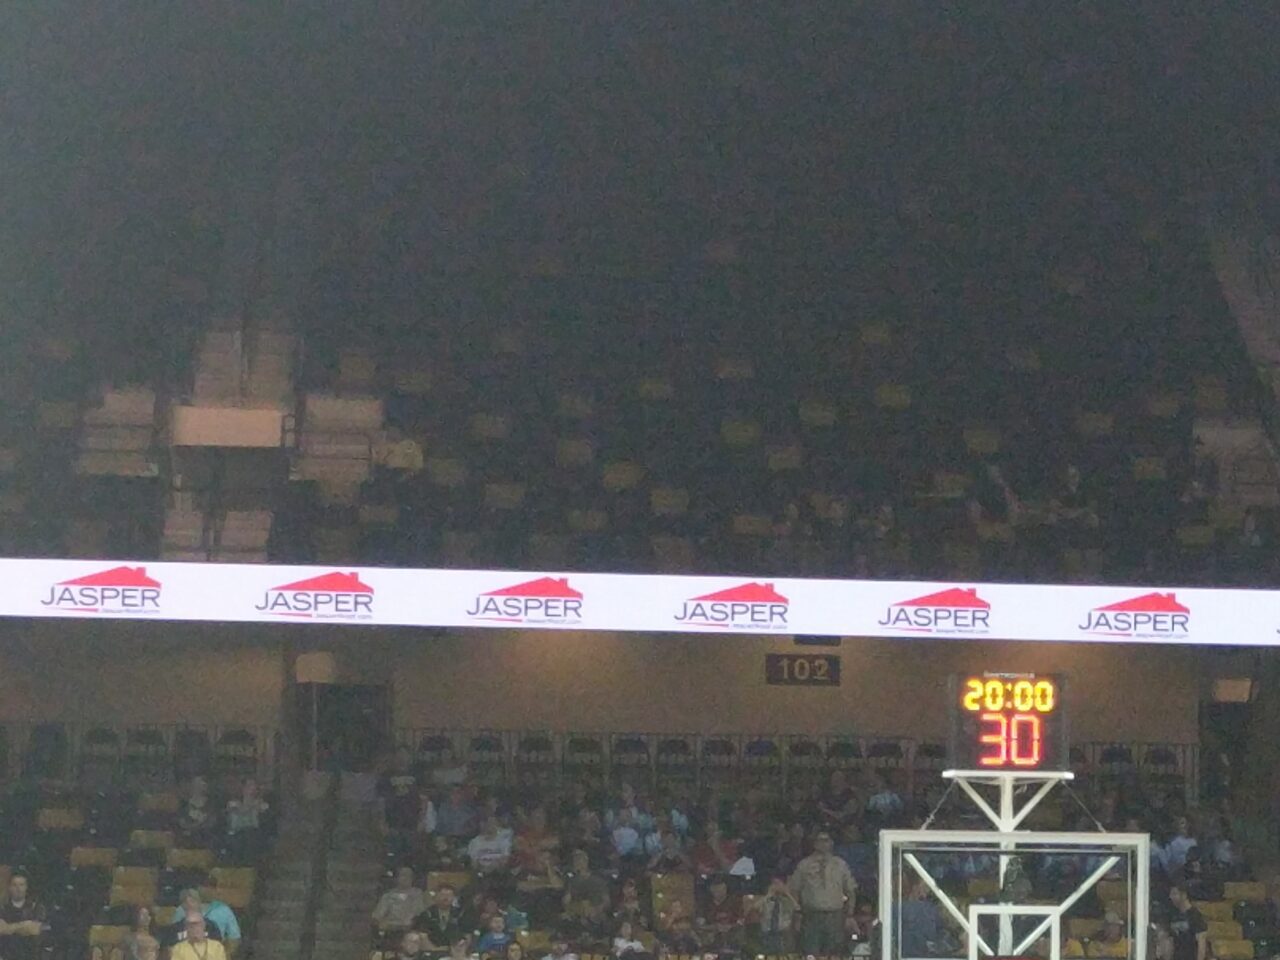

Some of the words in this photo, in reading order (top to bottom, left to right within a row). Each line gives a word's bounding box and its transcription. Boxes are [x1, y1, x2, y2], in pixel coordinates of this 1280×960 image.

[40, 586, 161, 608] JASPER
[255, 591, 374, 613] JASPER
[466, 597, 583, 618] JASPER
[674, 602, 789, 623] JASPER
[878, 607, 990, 628] JASPER
[1078, 611, 1189, 633] JASPER
[777, 658, 830, 681] 102
[963, 679, 1054, 712] 20:00
[980, 714, 1040, 765] 30
